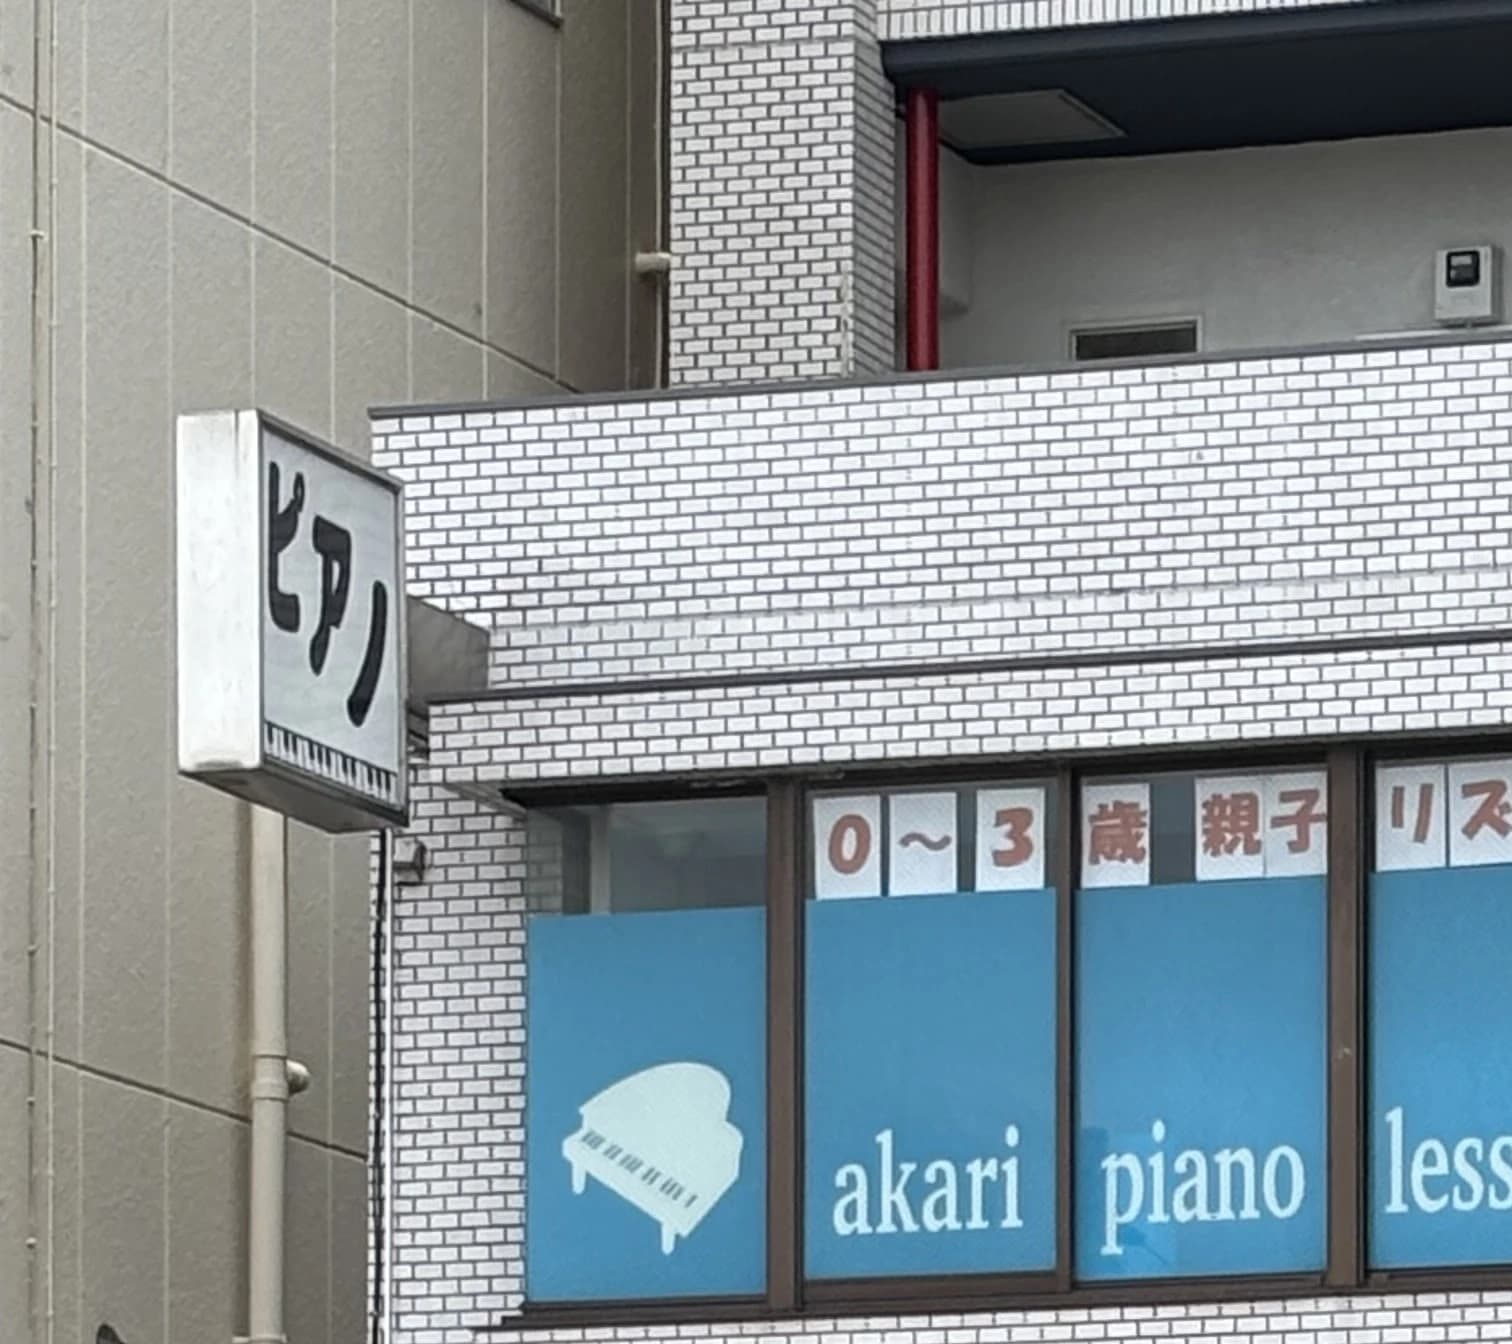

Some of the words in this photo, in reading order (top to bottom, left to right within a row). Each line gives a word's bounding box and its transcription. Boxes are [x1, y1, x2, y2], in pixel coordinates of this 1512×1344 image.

[268, 460, 389, 729] ピアノ
[1202, 788, 1328, 857] 親子
[832, 1123, 1024, 1236] akari
[1100, 1119, 1305, 1255] piano
